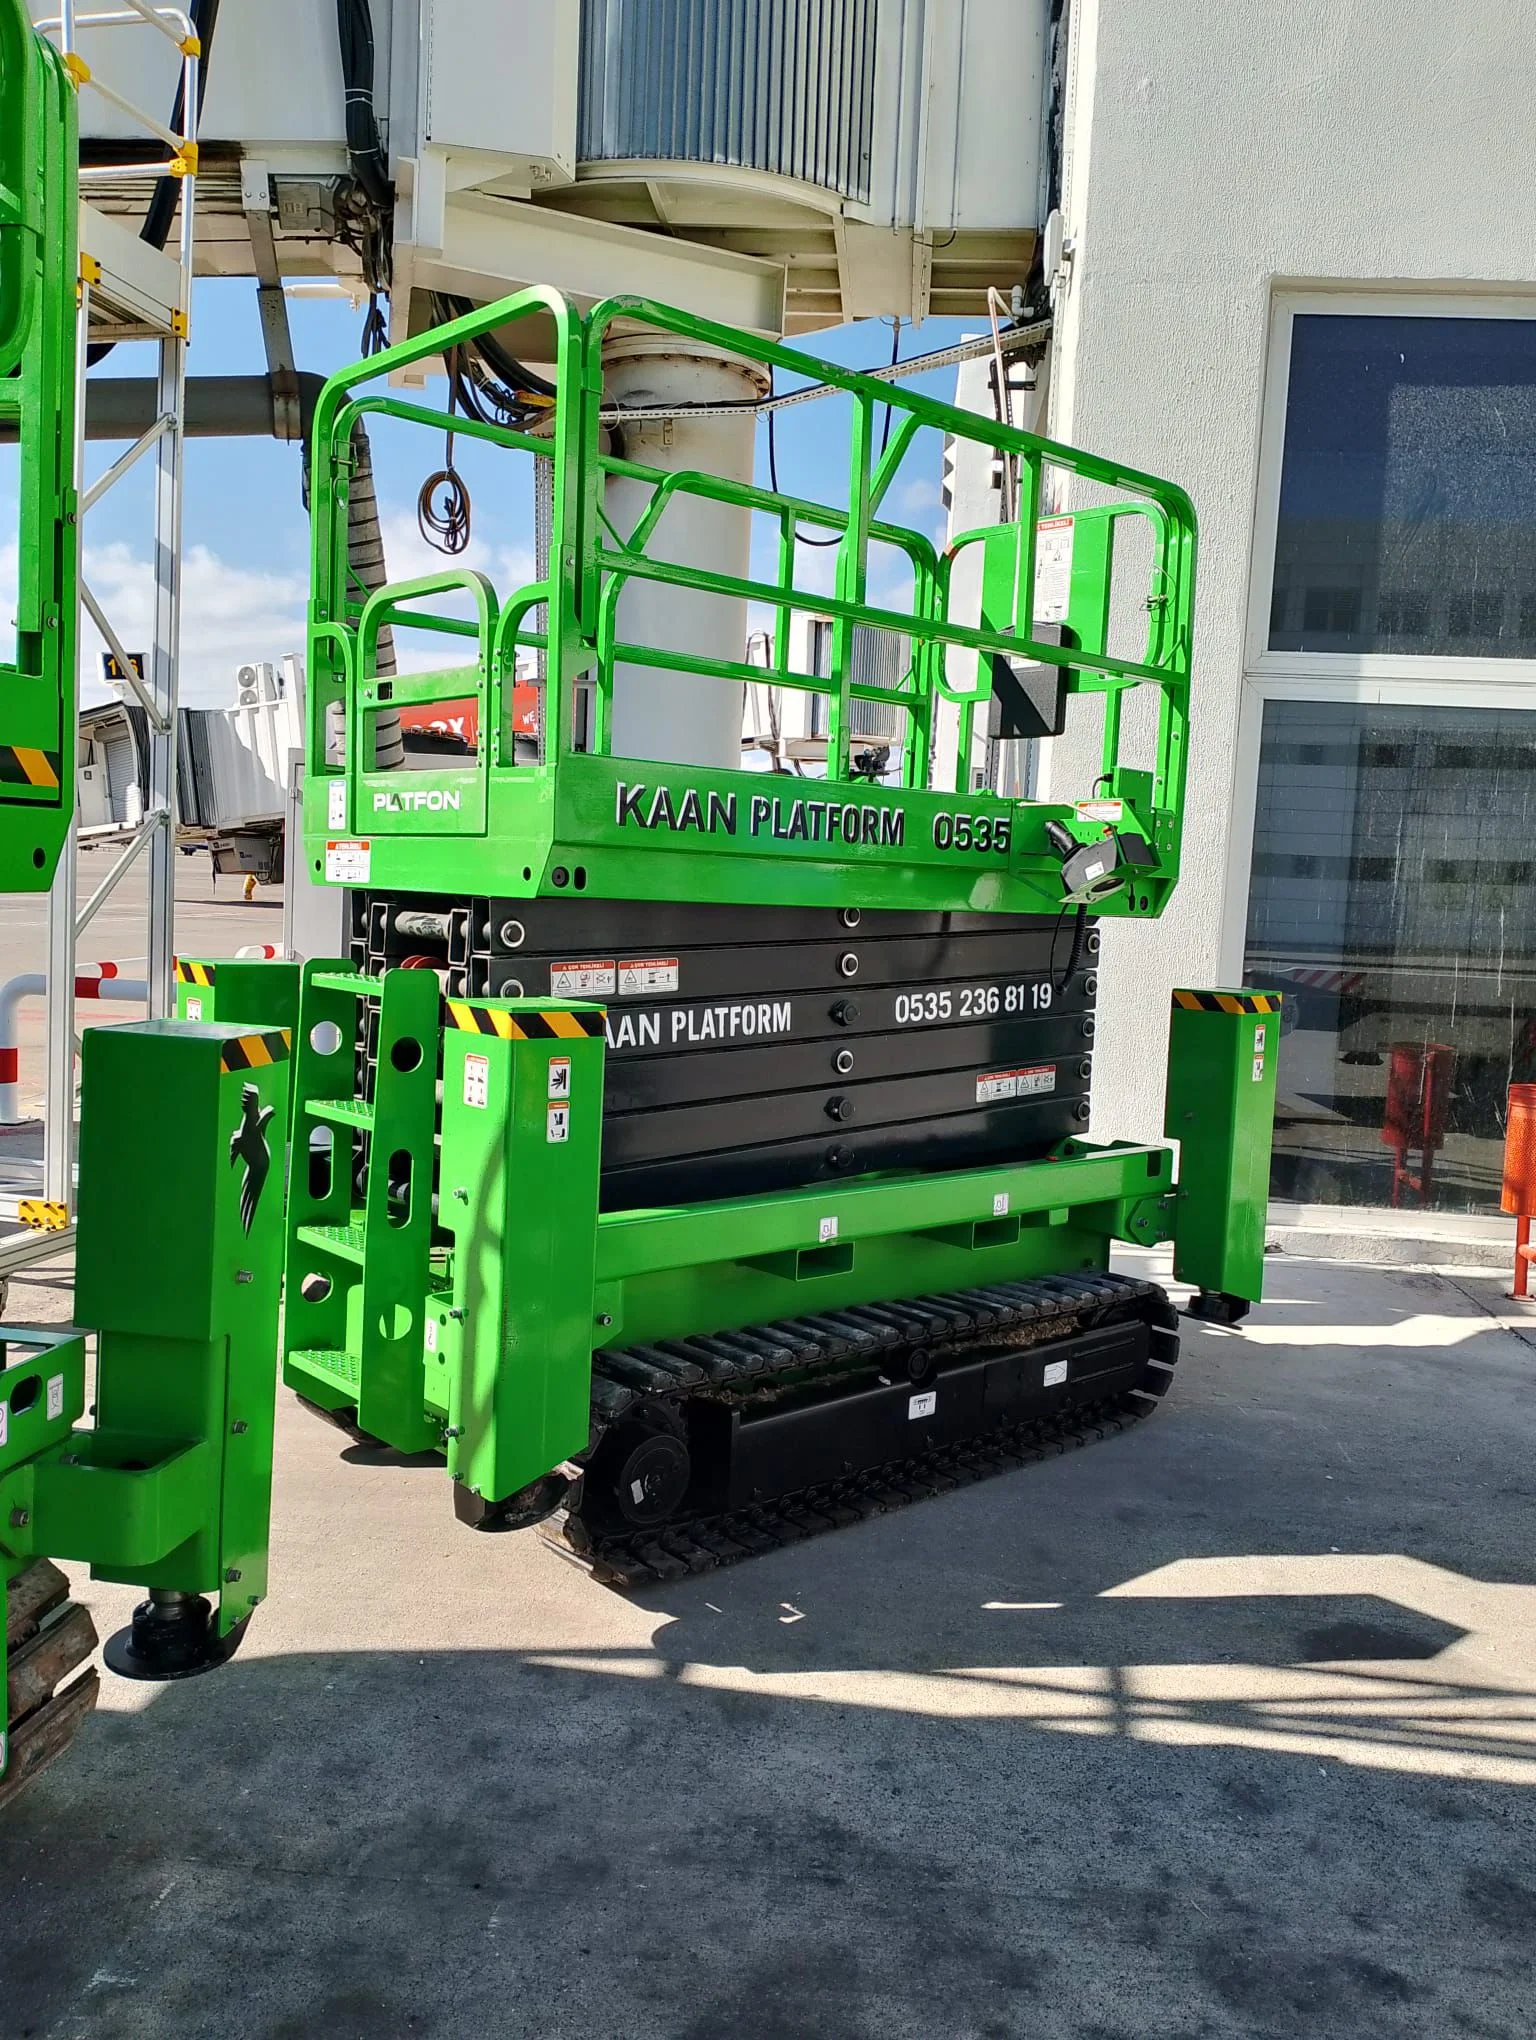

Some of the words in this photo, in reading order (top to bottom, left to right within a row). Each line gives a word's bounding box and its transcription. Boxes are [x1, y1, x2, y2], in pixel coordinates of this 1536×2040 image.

[108, 658, 138, 676] 16
[373, 790, 461, 813] PLATFON
[615, 781, 736, 836] KAAN
[750, 795, 905, 847] PLATFORM
[932, 811, 1010, 855] 0535
[895, 990, 953, 1024] 0535
[959, 986, 1000, 1017] 236
[1004, 983, 1025, 1012] 81
[1031, 982, 1052, 1010] 19
[604, 1012, 661, 1049] AAN
[671, 1001, 792, 1044] PLATFORM
